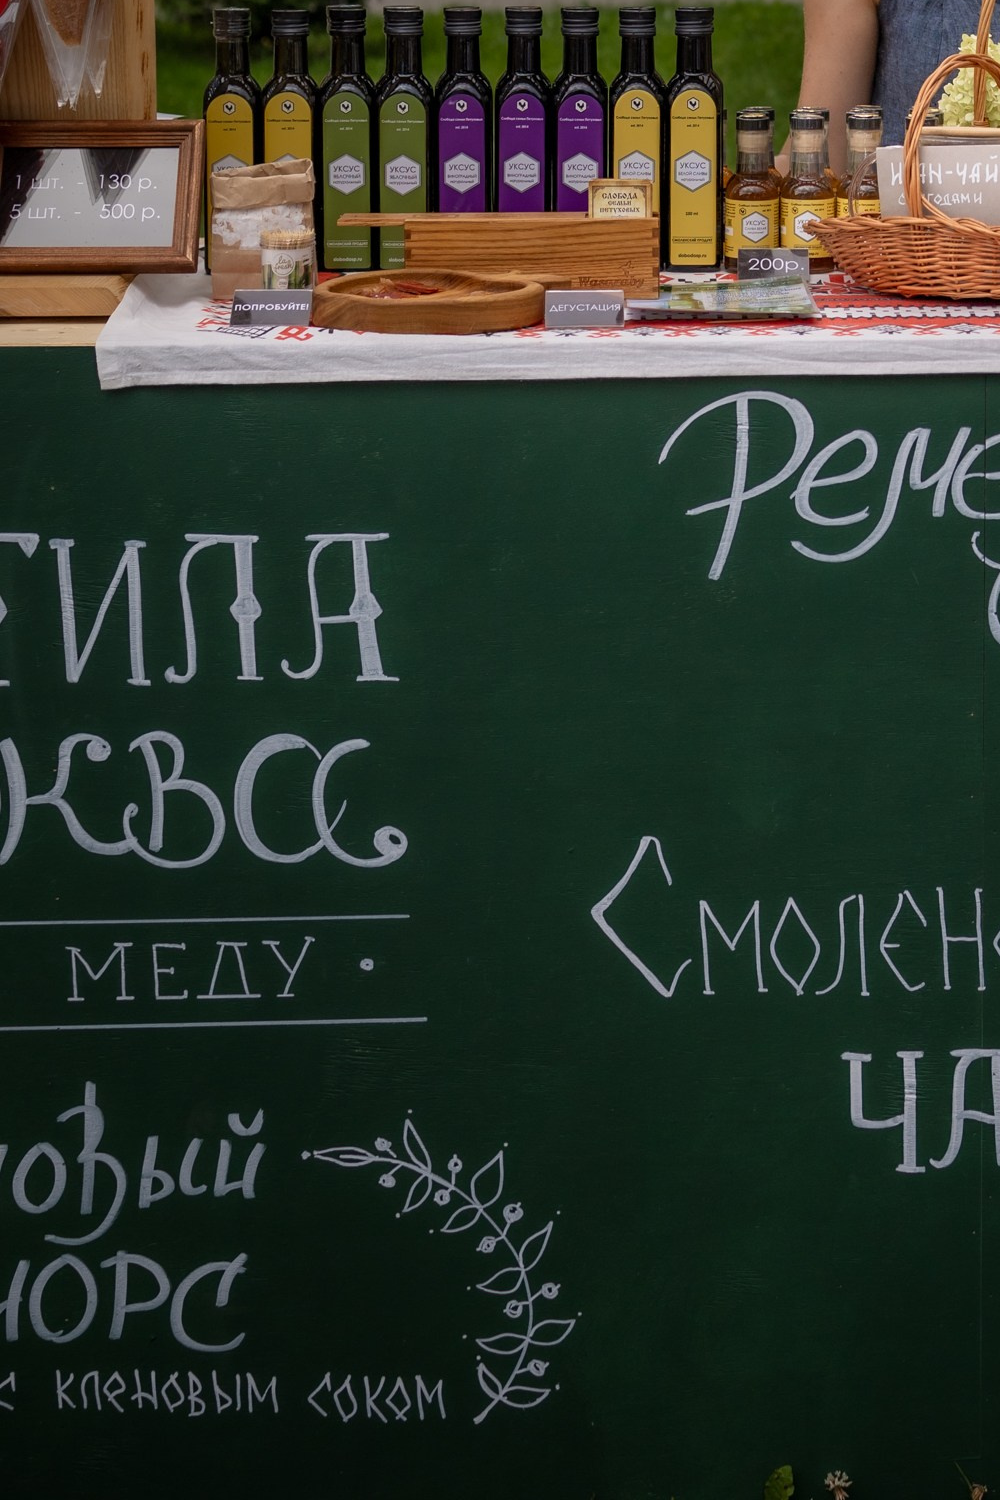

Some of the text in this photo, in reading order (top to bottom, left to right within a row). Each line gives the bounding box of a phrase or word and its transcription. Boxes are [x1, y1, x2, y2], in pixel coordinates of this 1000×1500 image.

[333, 165, 360, 173] УКСУС
[509, 163, 535, 171] УКСУС
[567, 163, 594, 171] УКСУС
[31, 177, 64, 190] шт.
[99, 174, 132, 190] 130
[138, 177, 158, 193] р.
[601, 192, 638, 200] СЛОБОДА
[9, 204, 22, 219] 5
[28, 207, 61, 220] шт.
[99, 204, 135, 220] 500
[141, 206, 161, 223] р.
[745, 219, 766, 227] УКСУС
[748, 257, 805, 273] 200р.
[234, 302, 309, 311] ПОПРОБУЙТЕ!
[549, 303, 621, 312] ДЕГУСТАЦИЯ
[65, 935, 316, 1002] МЕДУ
[307, 1371, 447, 1423] СОКОМ
